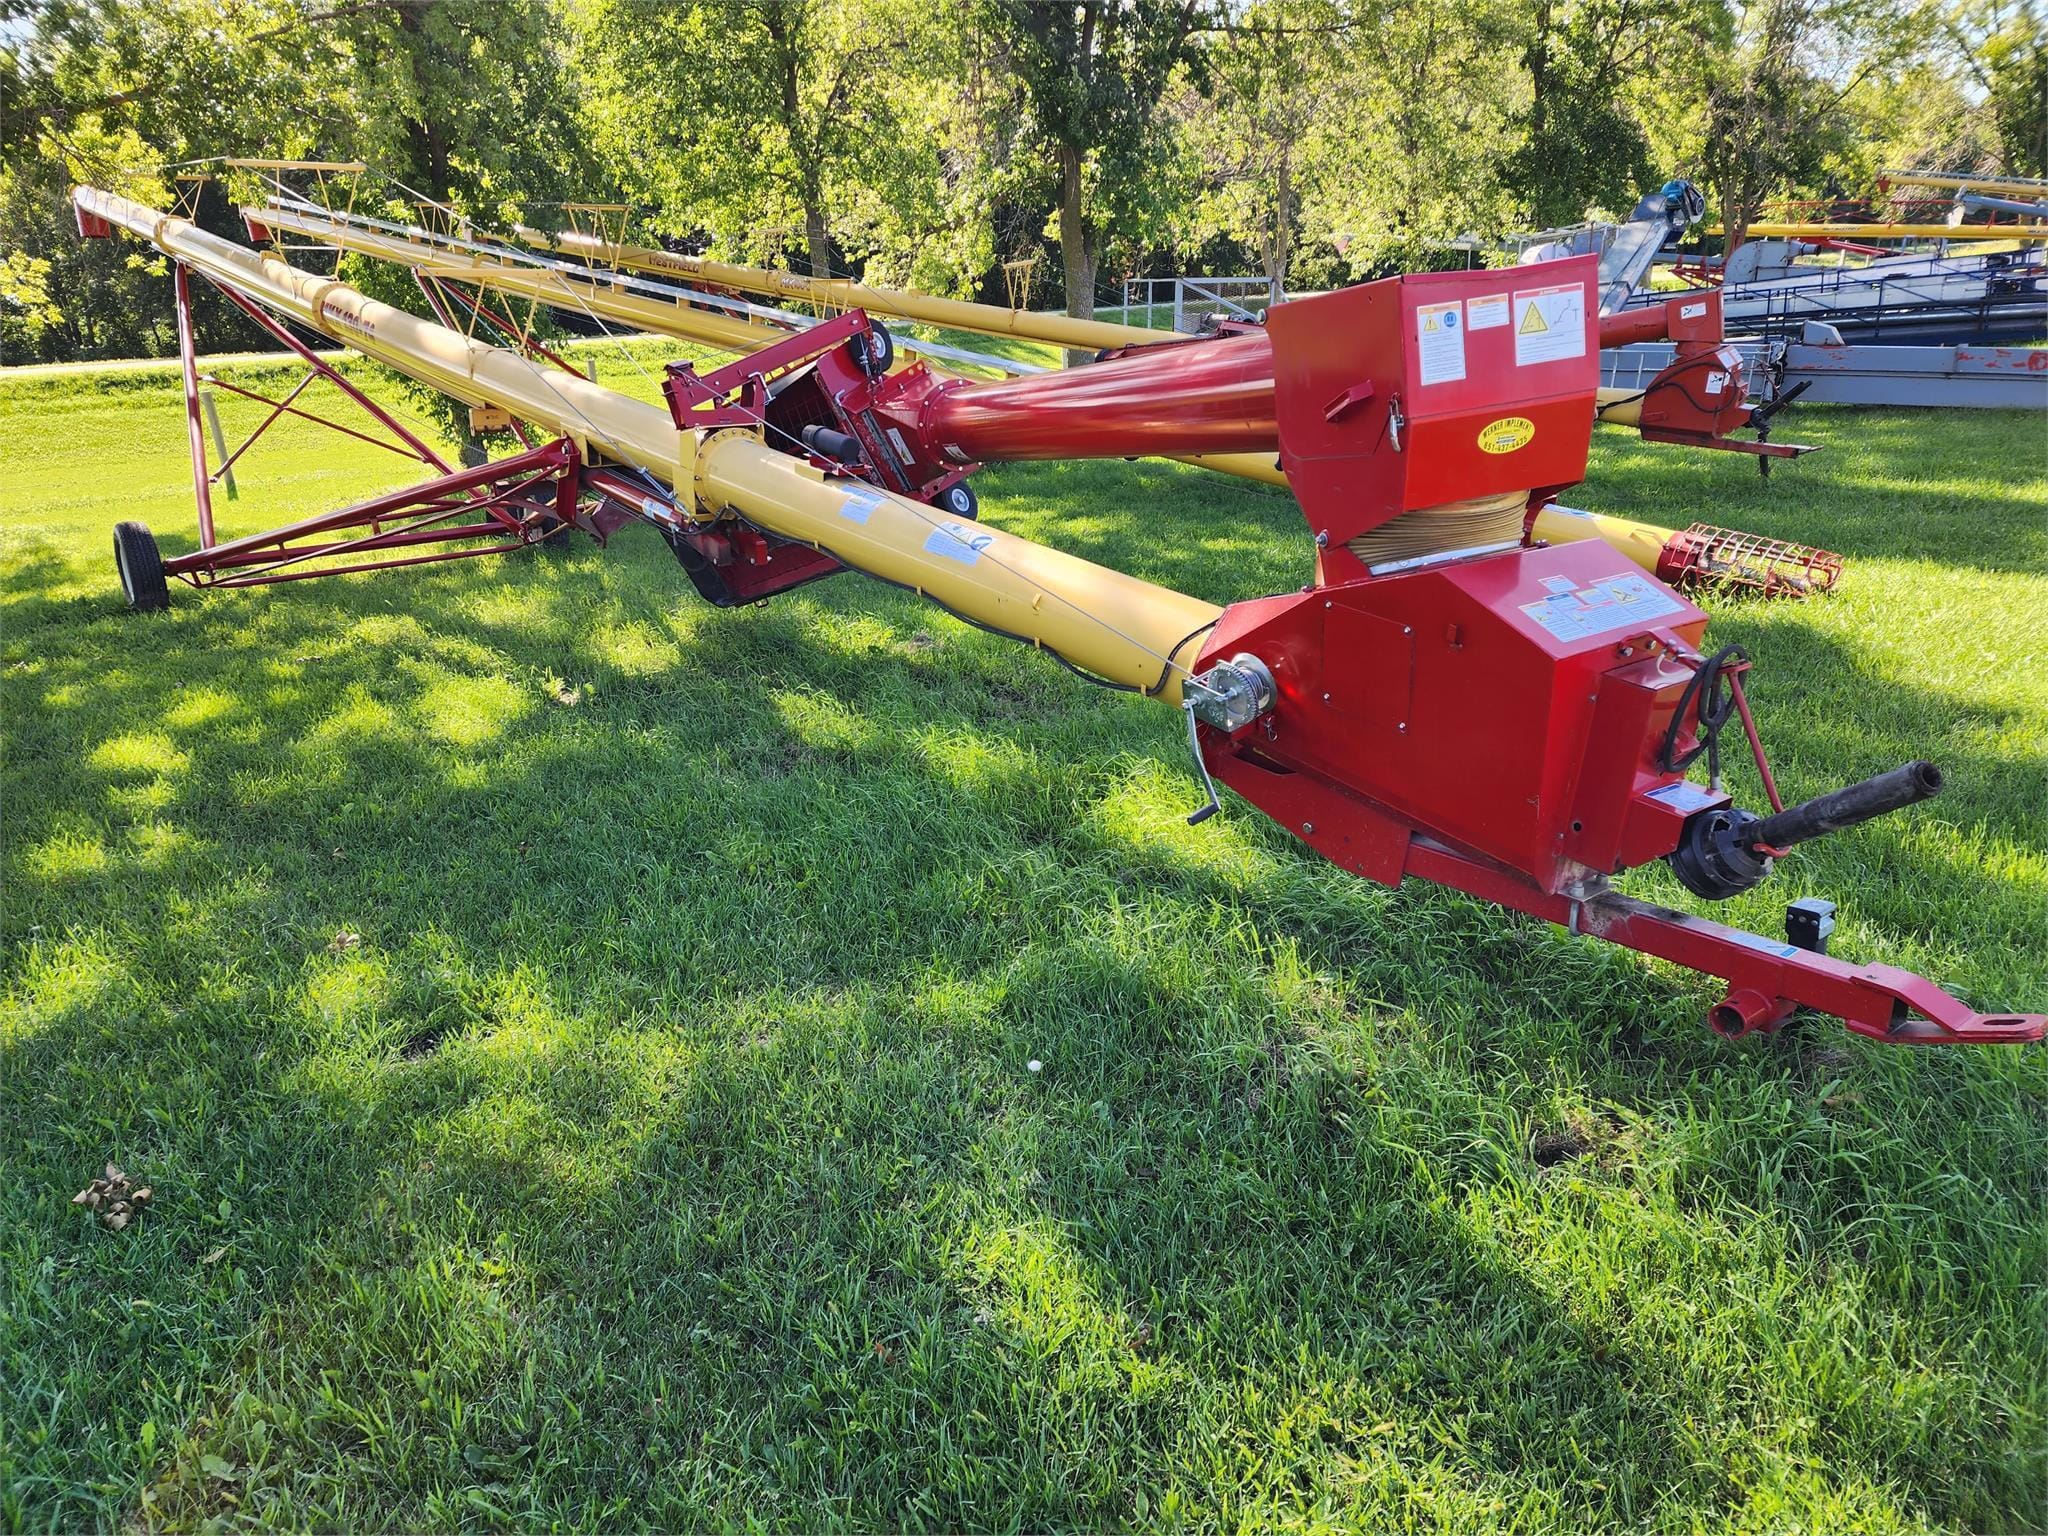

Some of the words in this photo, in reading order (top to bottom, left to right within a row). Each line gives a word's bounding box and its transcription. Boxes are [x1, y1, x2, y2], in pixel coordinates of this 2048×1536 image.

[648, 254, 699, 273] WESTFIELD
[1483, 421, 1504, 439] WERNER
[1504, 418, 1532, 432] IMPLEMENT
